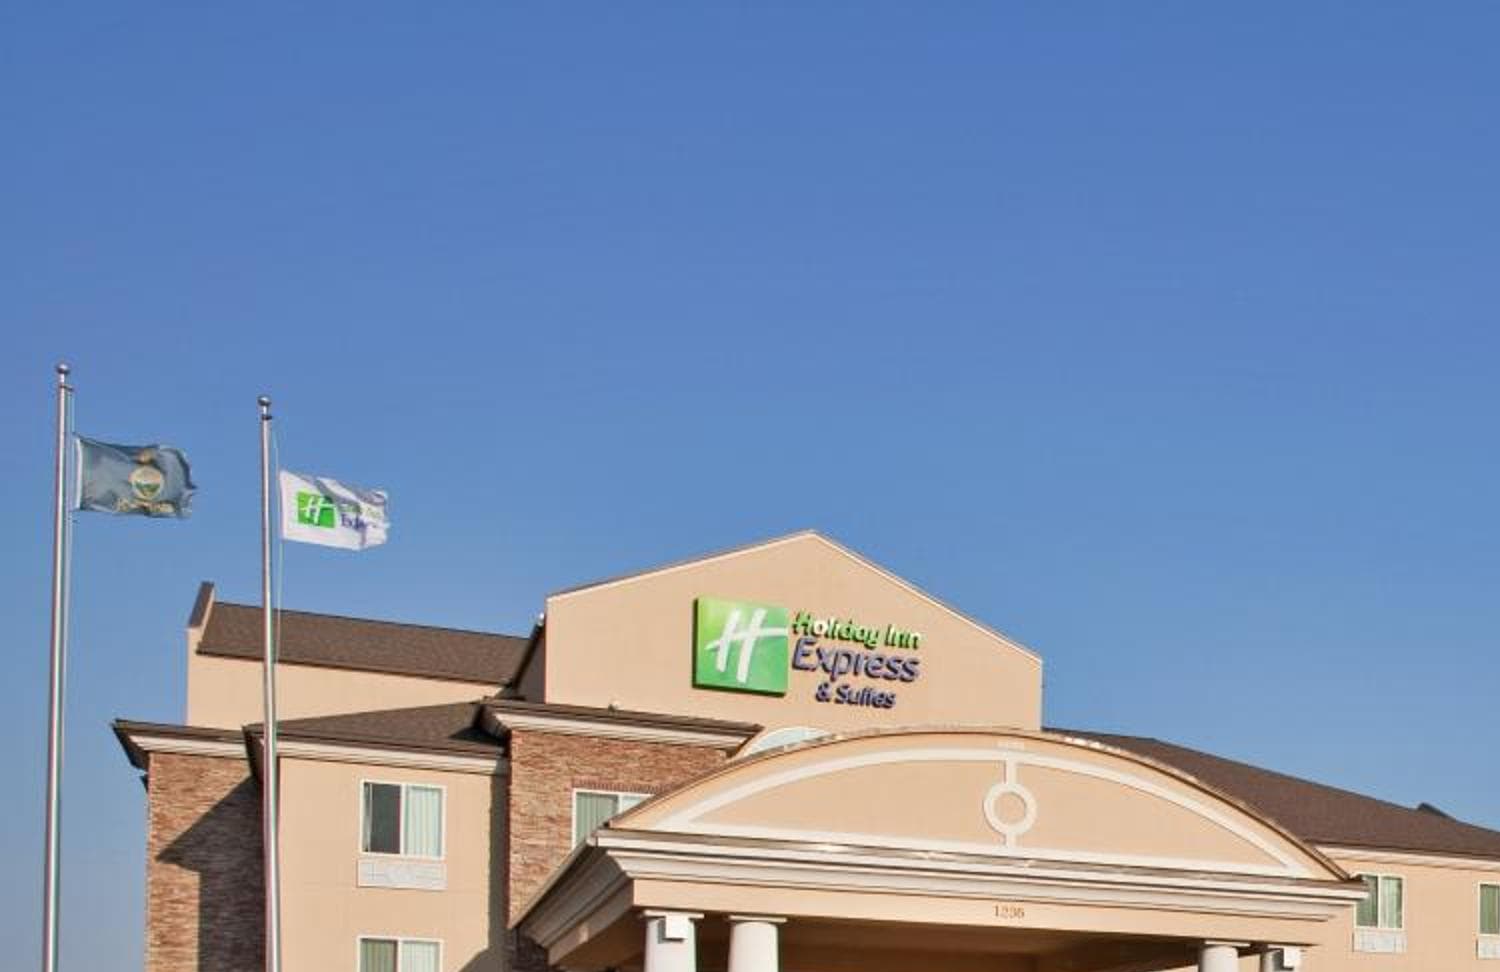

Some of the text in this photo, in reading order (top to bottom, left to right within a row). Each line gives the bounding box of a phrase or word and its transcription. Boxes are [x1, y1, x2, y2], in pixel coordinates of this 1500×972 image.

[792, 610, 922, 650] Holiday Inn
[791, 635, 921, 683] Express
[815, 680, 896, 709] & Suites
